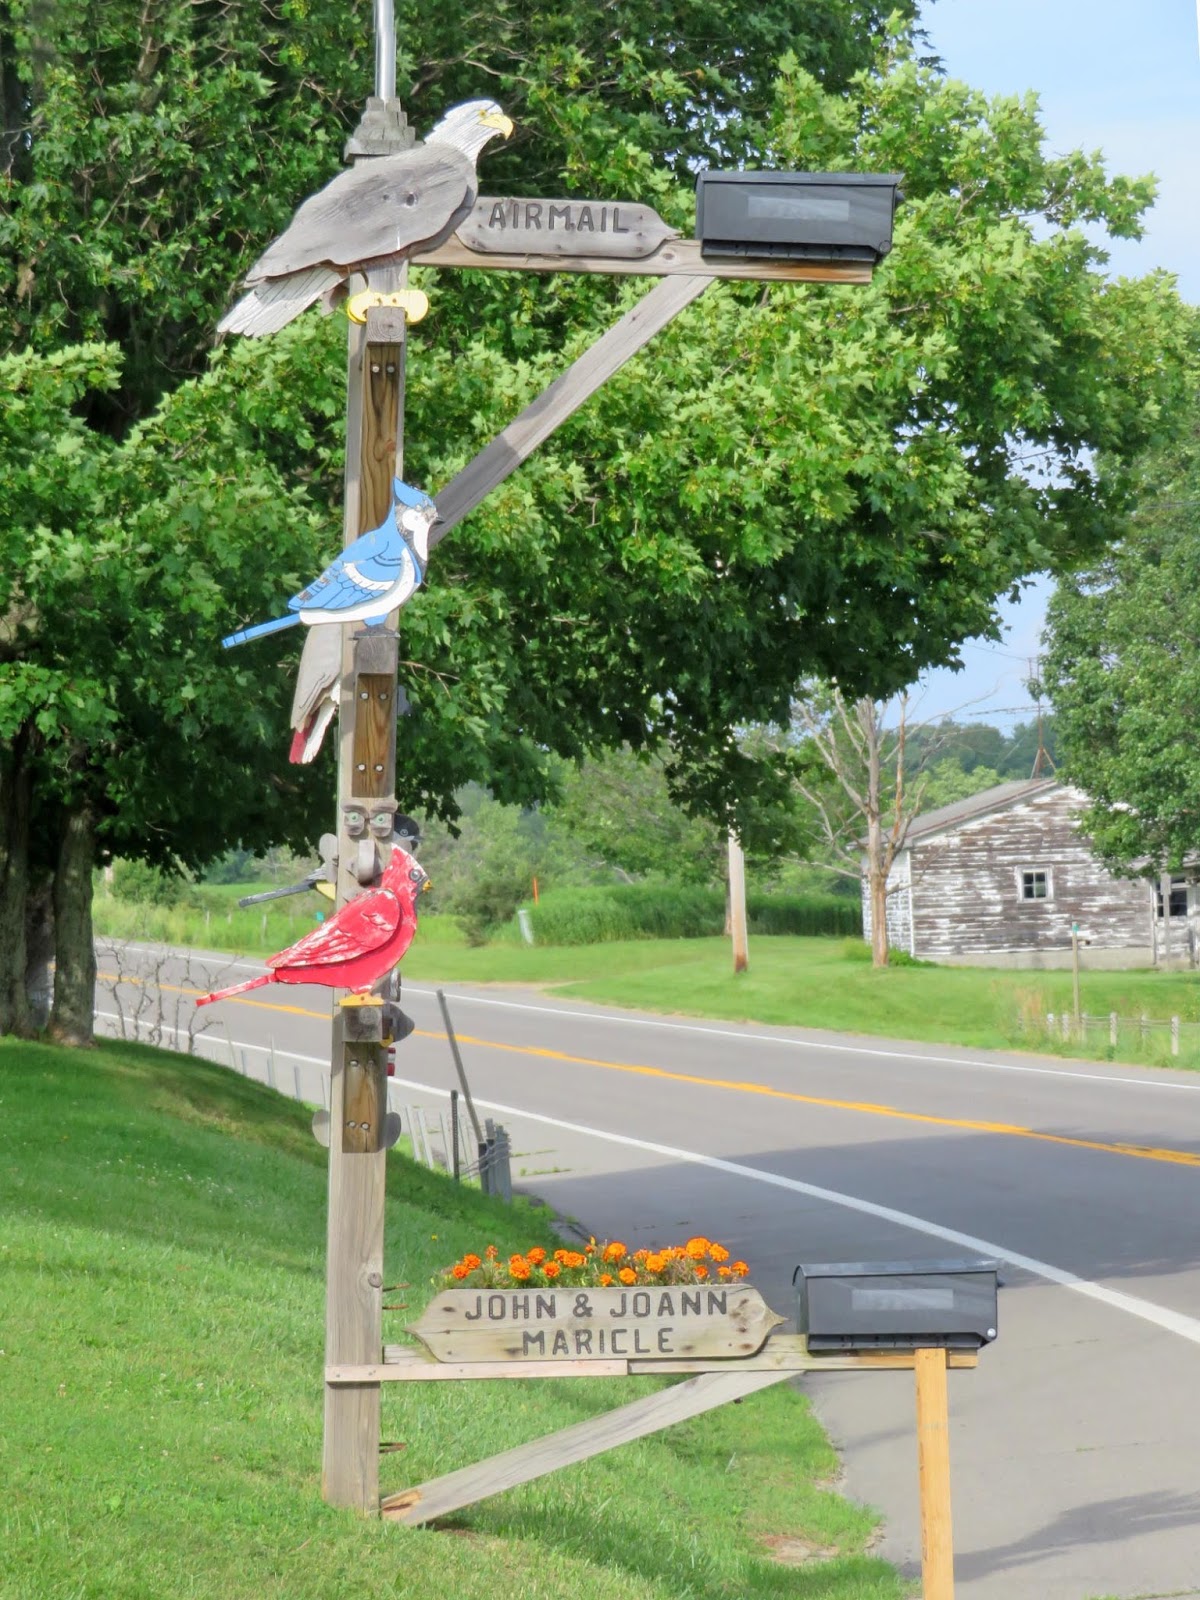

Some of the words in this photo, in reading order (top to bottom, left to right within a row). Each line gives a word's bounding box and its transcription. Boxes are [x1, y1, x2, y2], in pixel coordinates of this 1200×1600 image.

[488, 203, 630, 233] AIRMAIL
[465, 1293, 556, 1321] JOHN
[572, 1293, 593, 1318] &
[609, 1290, 727, 1318] JOANN
[522, 1327, 674, 1356] MARICLE
